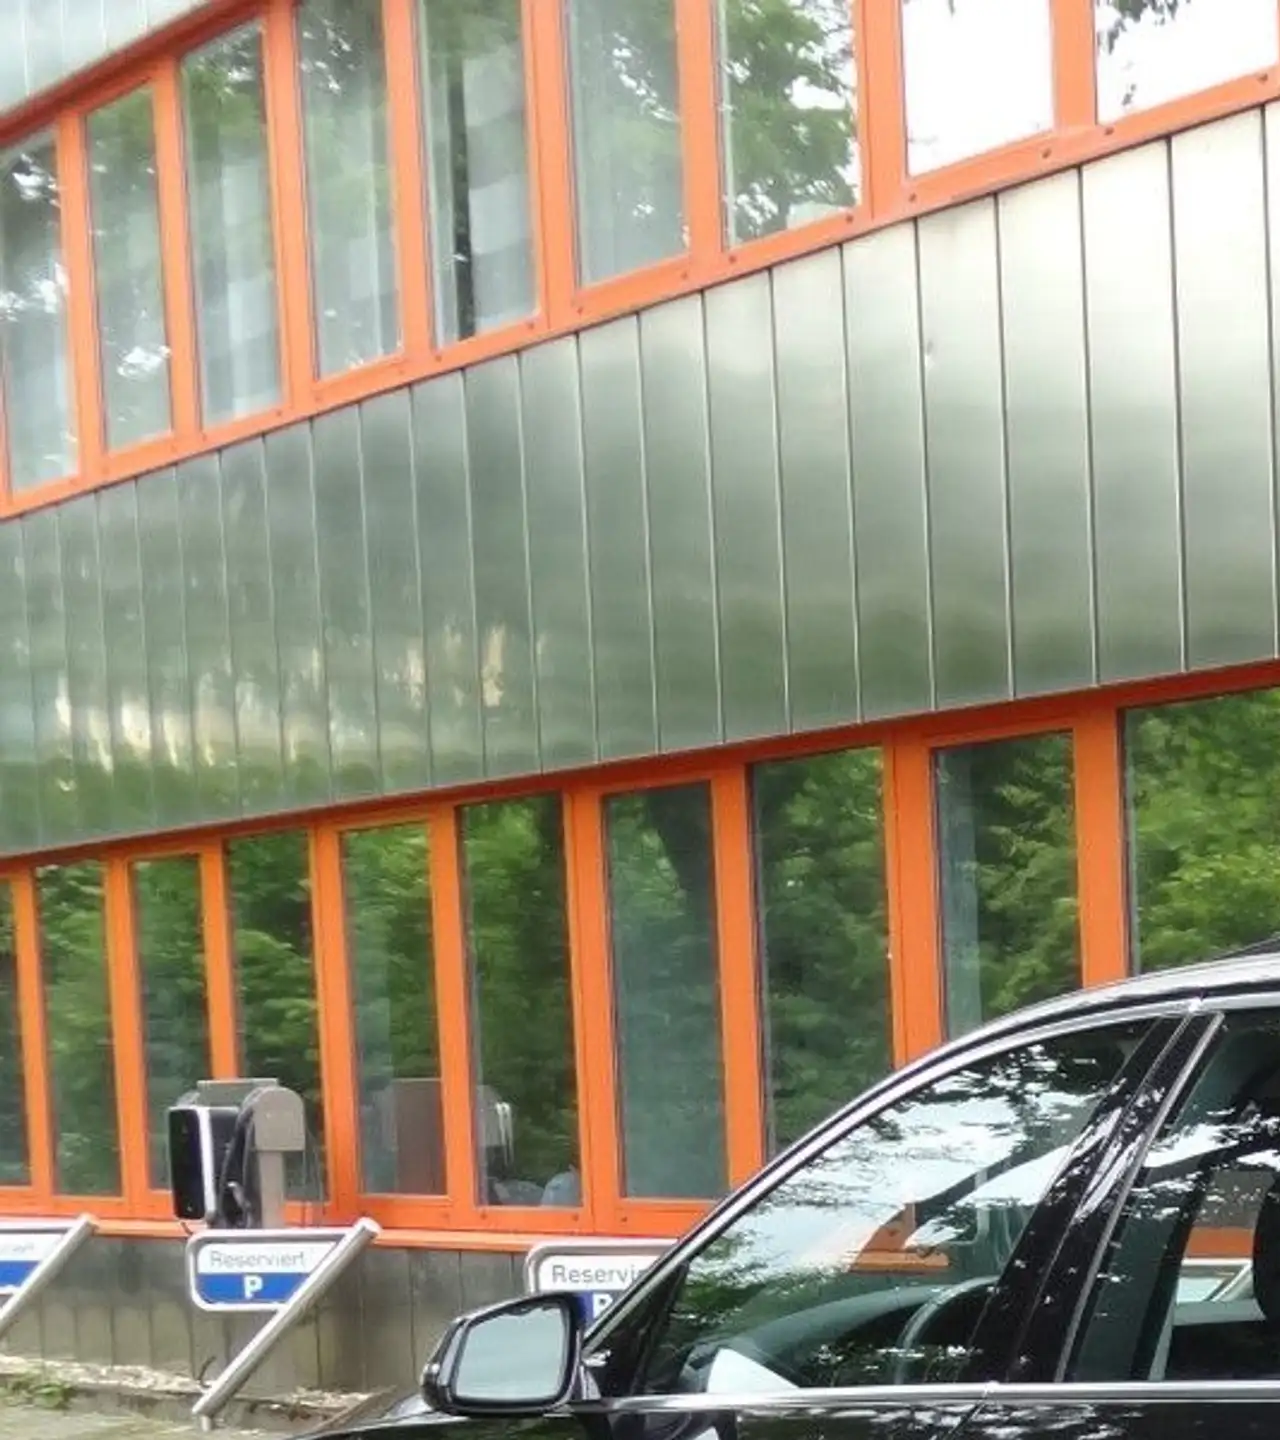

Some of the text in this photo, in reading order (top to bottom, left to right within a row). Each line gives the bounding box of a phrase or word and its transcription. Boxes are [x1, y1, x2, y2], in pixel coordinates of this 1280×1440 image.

[210, 1250, 305, 1269] Reserviert
[243, 1275, 264, 1299] P
[591, 1291, 614, 1318] P
